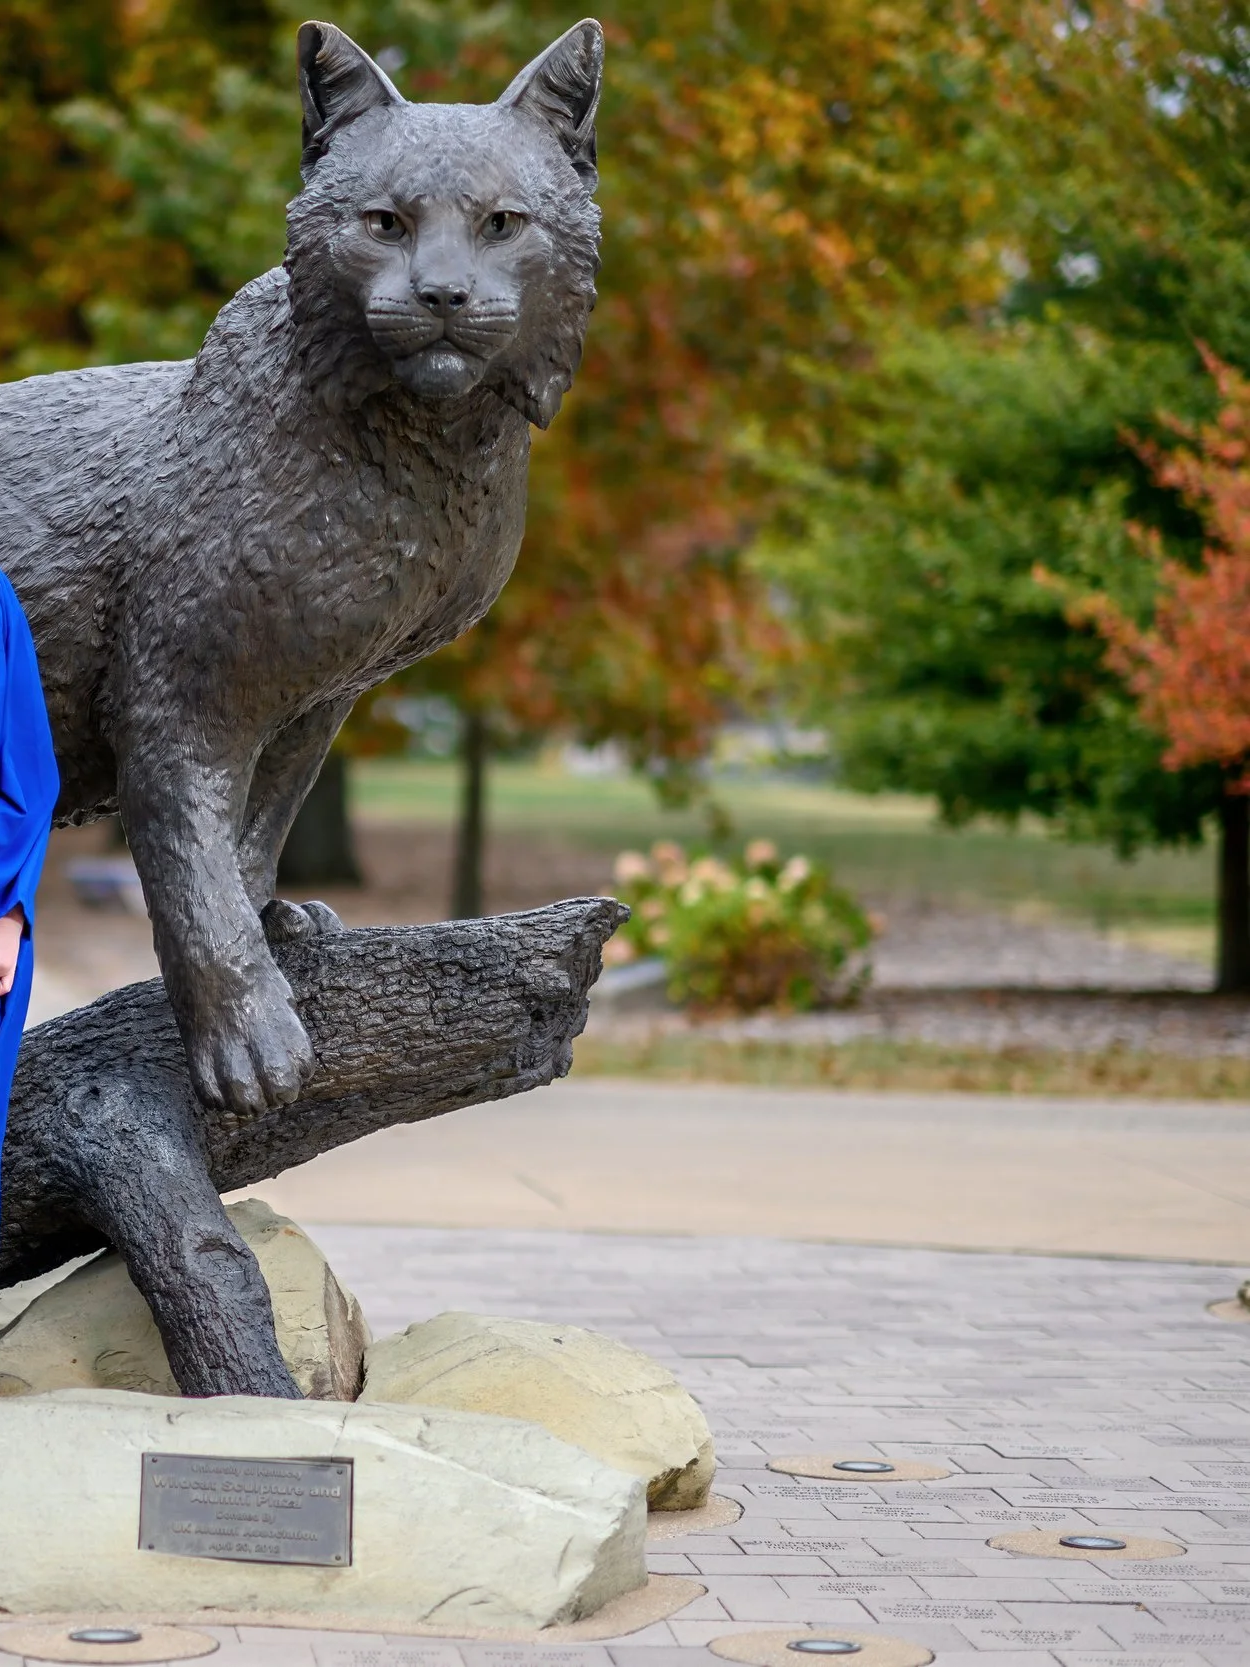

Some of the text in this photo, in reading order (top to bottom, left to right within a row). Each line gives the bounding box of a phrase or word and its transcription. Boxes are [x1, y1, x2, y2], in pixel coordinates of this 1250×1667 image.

[191, 1463, 303, 1481] University of Kentucky
[151, 1474, 342, 1499] Wildcat Sculpture and
[190, 1493, 303, 1511] Alumni Plaza
[215, 1510, 277, 1525] Donated By
[170, 1523, 319, 1543] UK Alumni Association
